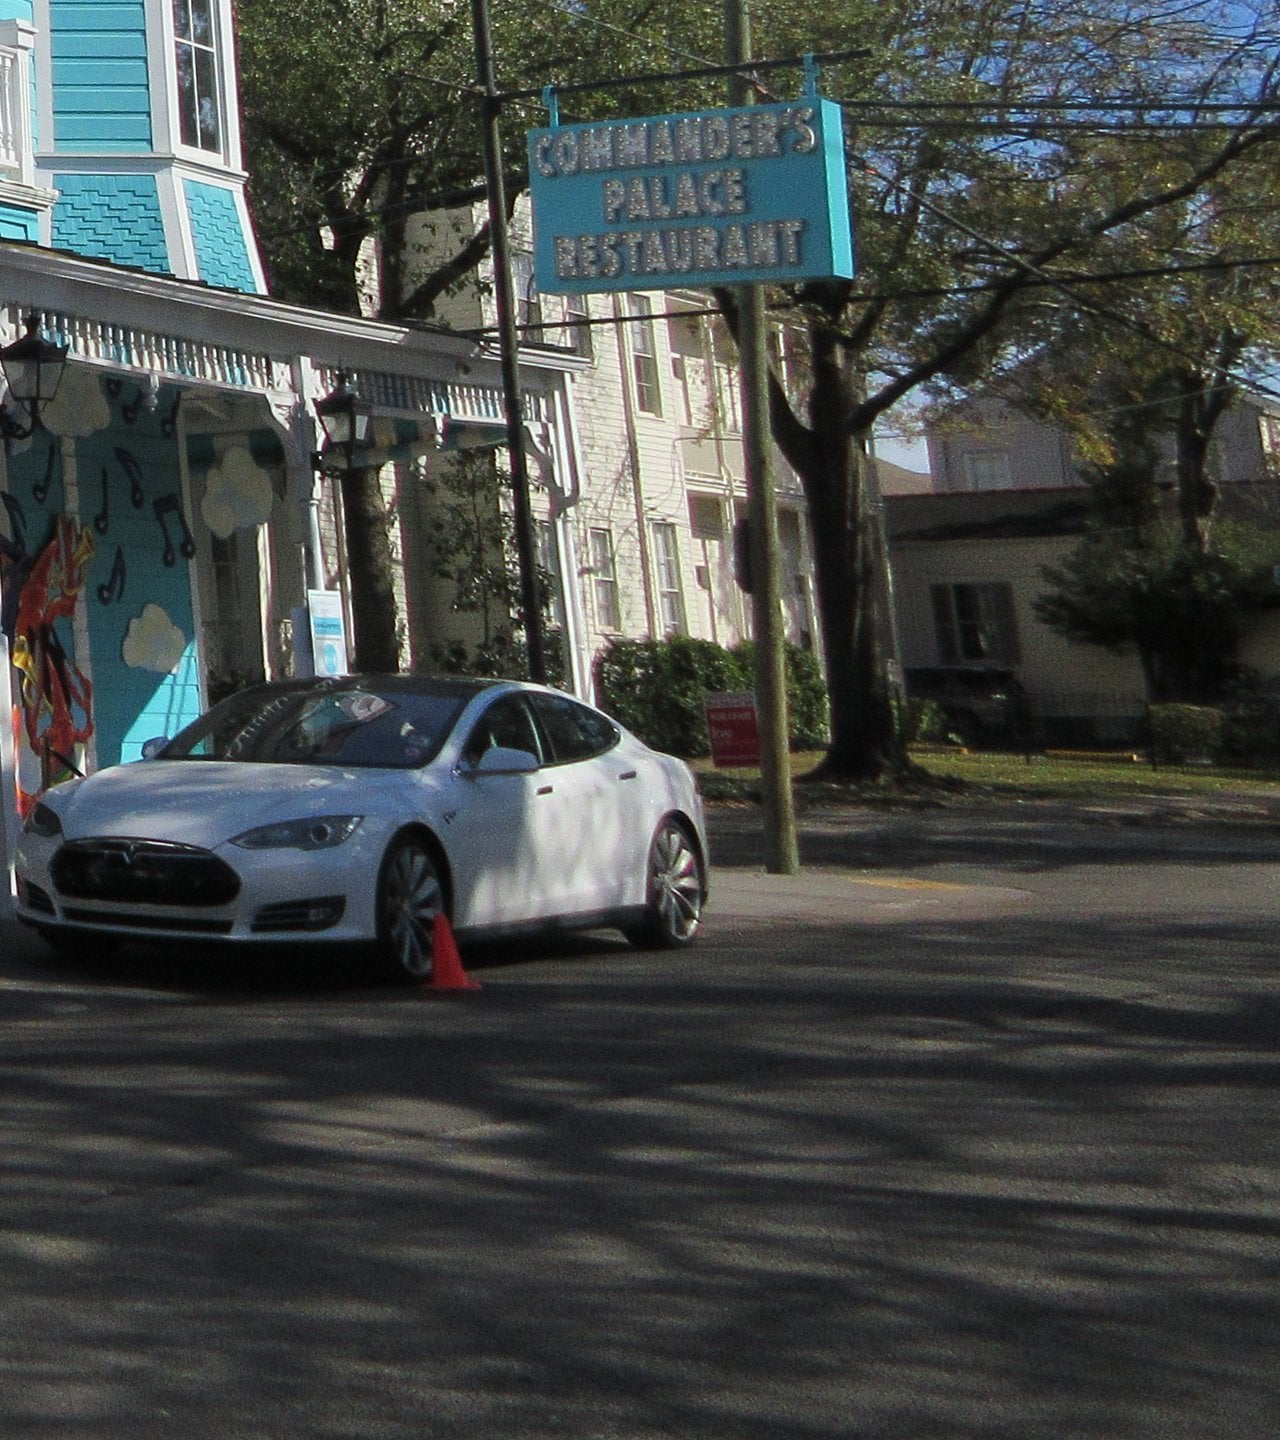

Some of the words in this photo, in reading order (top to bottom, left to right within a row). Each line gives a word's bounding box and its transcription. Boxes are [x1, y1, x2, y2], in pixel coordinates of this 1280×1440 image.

[535, 107, 816, 178] COMMANDER'S
[602, 167, 747, 224] PALACE
[553, 218, 804, 280] RESTAURANT
